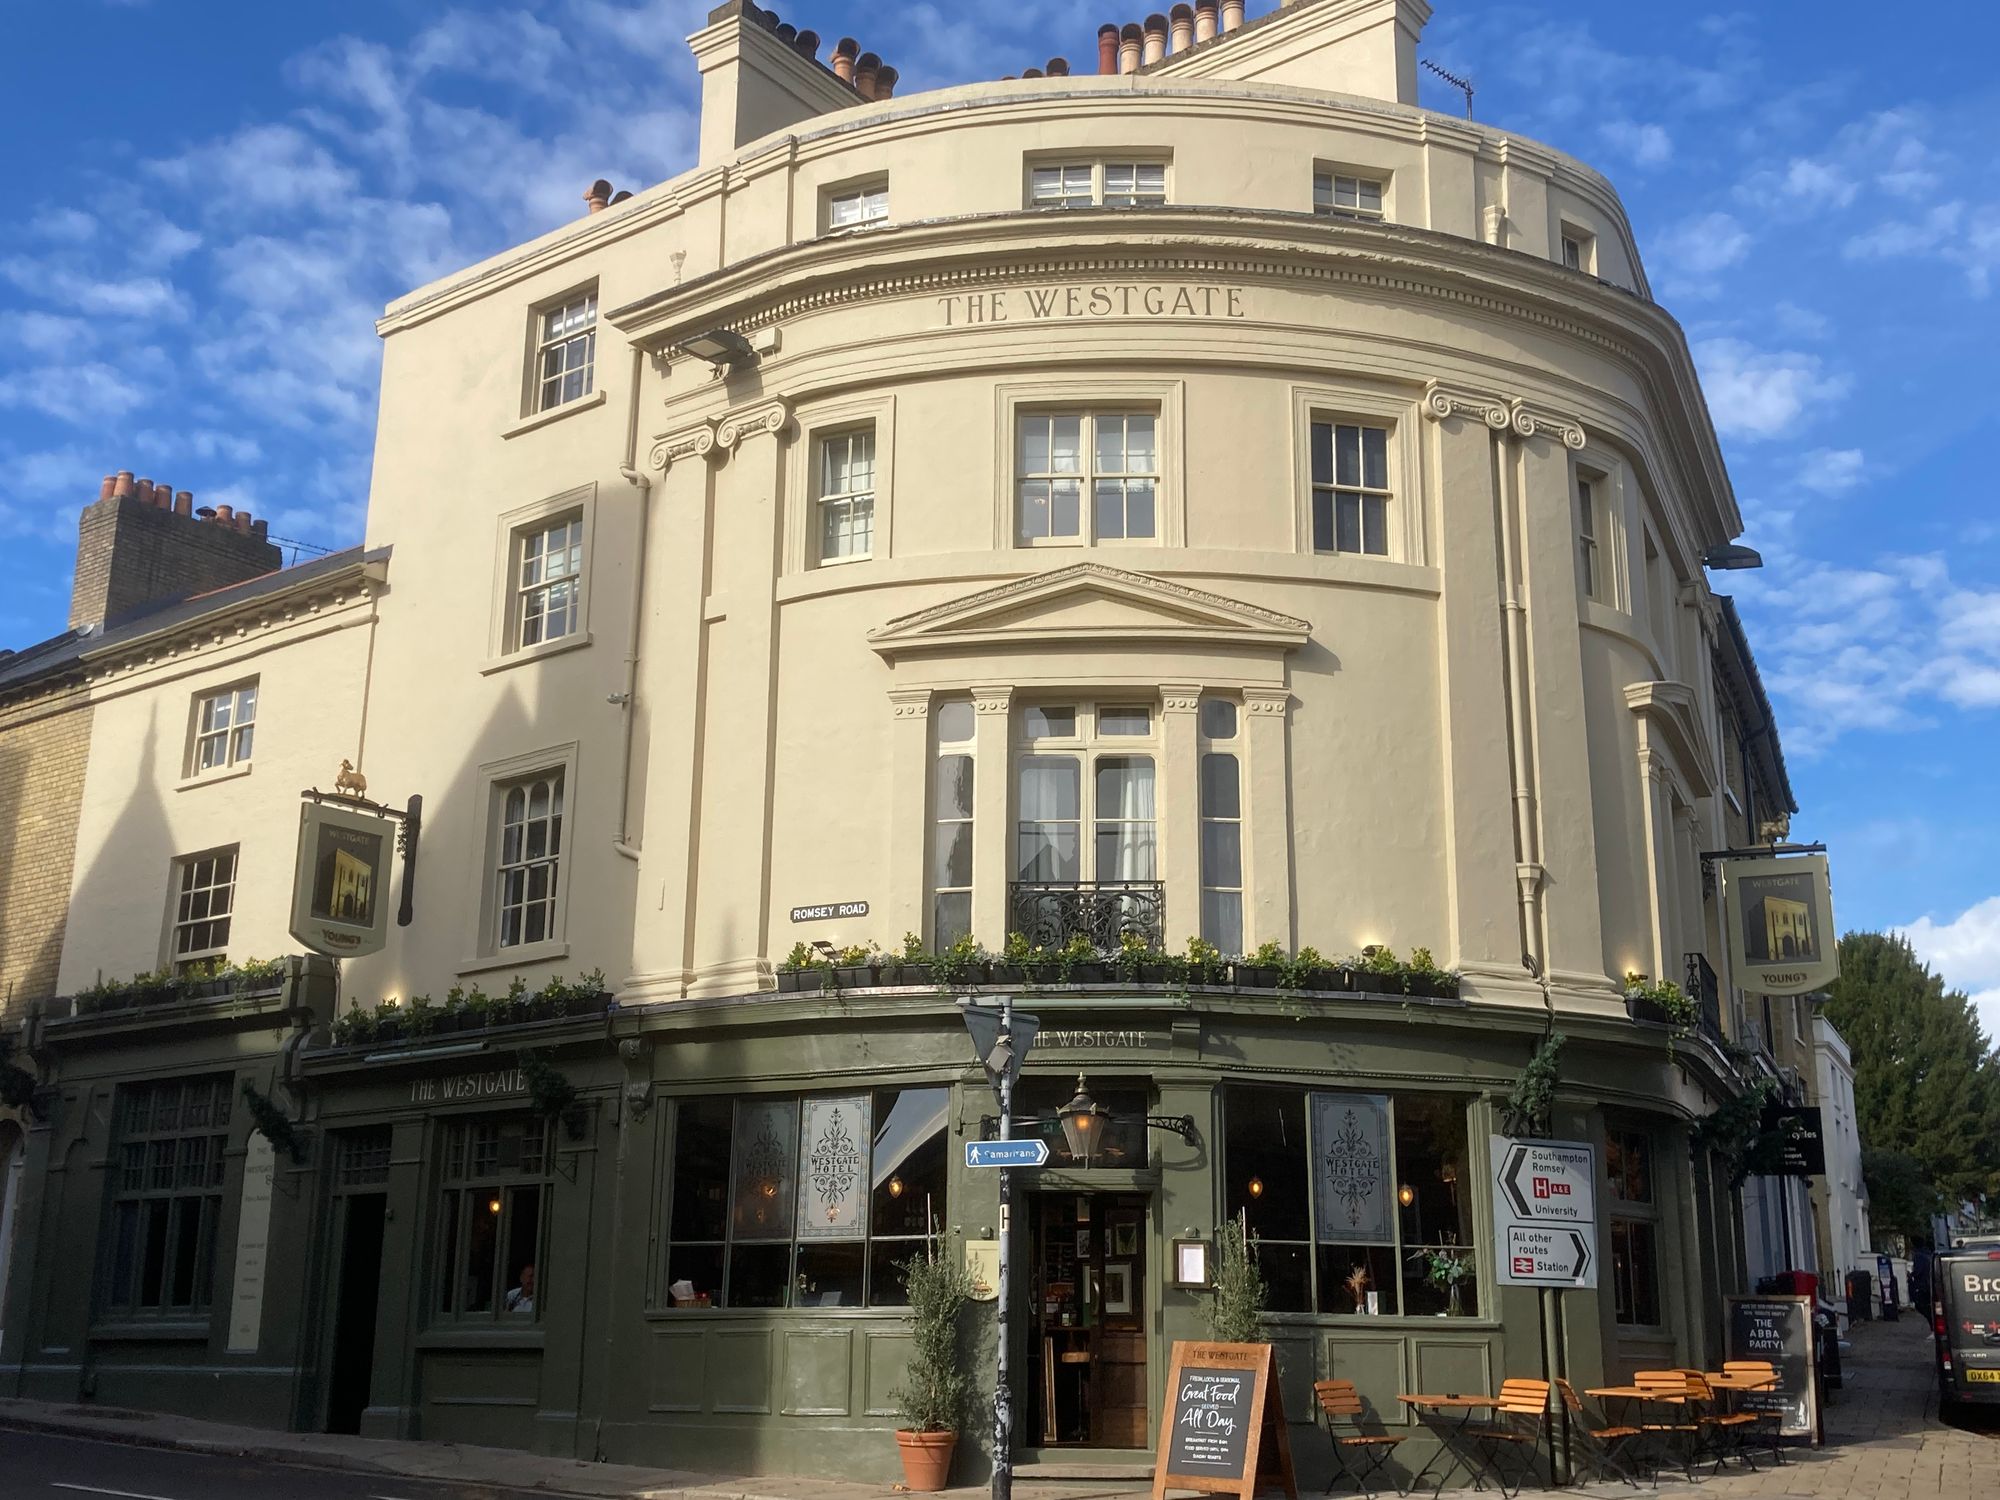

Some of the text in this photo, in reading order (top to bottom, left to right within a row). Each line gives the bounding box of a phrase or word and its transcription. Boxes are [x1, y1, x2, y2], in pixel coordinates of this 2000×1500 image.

[938, 286, 1245, 326] THE WESTGATE
[1752, 878, 1800, 888] WESTGATE
[793, 903, 866, 920] ROMSEY ROAD
[1761, 972, 1808, 983] YOUNG'S
[1033, 1031, 1148, 1048] HE WESTGATE
[410, 1069, 526, 1102] THE WESTGATE
[811, 1156, 860, 1166] WESTGATE
[1531, 1151, 1588, 1164] Southampton
[1325, 1158, 1380, 1169] WESTGATE
[1532, 1163, 1566, 1175] Romsey
[814, 1165, 854, 1174] HOTEL
[1331, 1167, 1375, 1177] HOTEL
[1535, 1179, 1569, 1197] H A&E
[1535, 1204, 1578, 1218] University
[1513, 1232, 1553, 1243] All other
[1519, 1245, 1549, 1255] routes
[1537, 1262, 1569, 1272] Station
[1754, 1318, 1773, 1328] THE
[1749, 1329, 1780, 1339] ABBA
[1749, 1340, 1784, 1350] PARTY!
[1193, 1350, 1248, 1361] THE WESTGATE
[1181, 1383, 1240, 1405] Great Food
[1180, 1407, 1237, 1436] All Day
